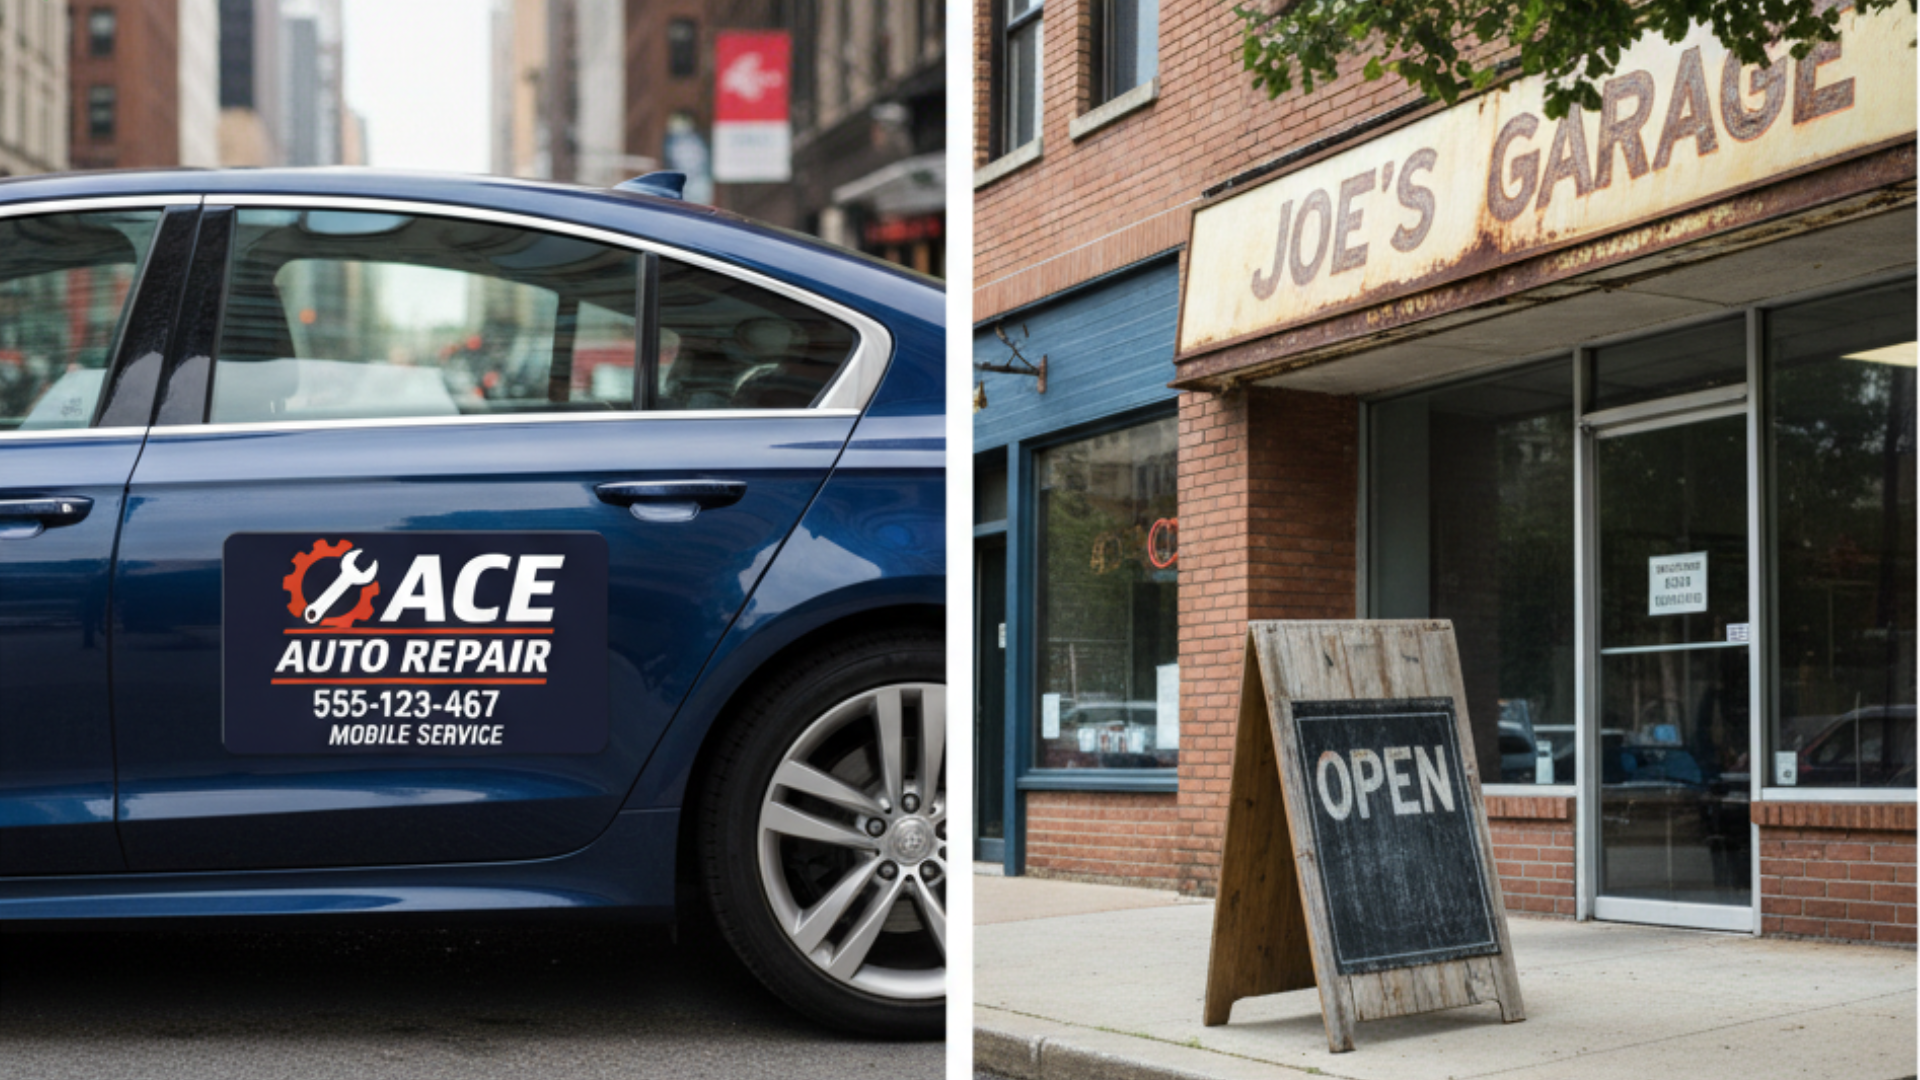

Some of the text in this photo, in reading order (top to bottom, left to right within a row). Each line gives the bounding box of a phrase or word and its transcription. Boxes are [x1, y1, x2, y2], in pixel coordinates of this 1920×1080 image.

[1251, 0, 1855, 300] JOE'S GARAGE
[379, 553, 565, 623] ACE
[274, 638, 552, 673] AUTO REPAIR
[313, 688, 500, 719] 555-123-467
[328, 723, 504, 746] MOBILE SERVICE
[1316, 745, 1455, 821] OPEN
